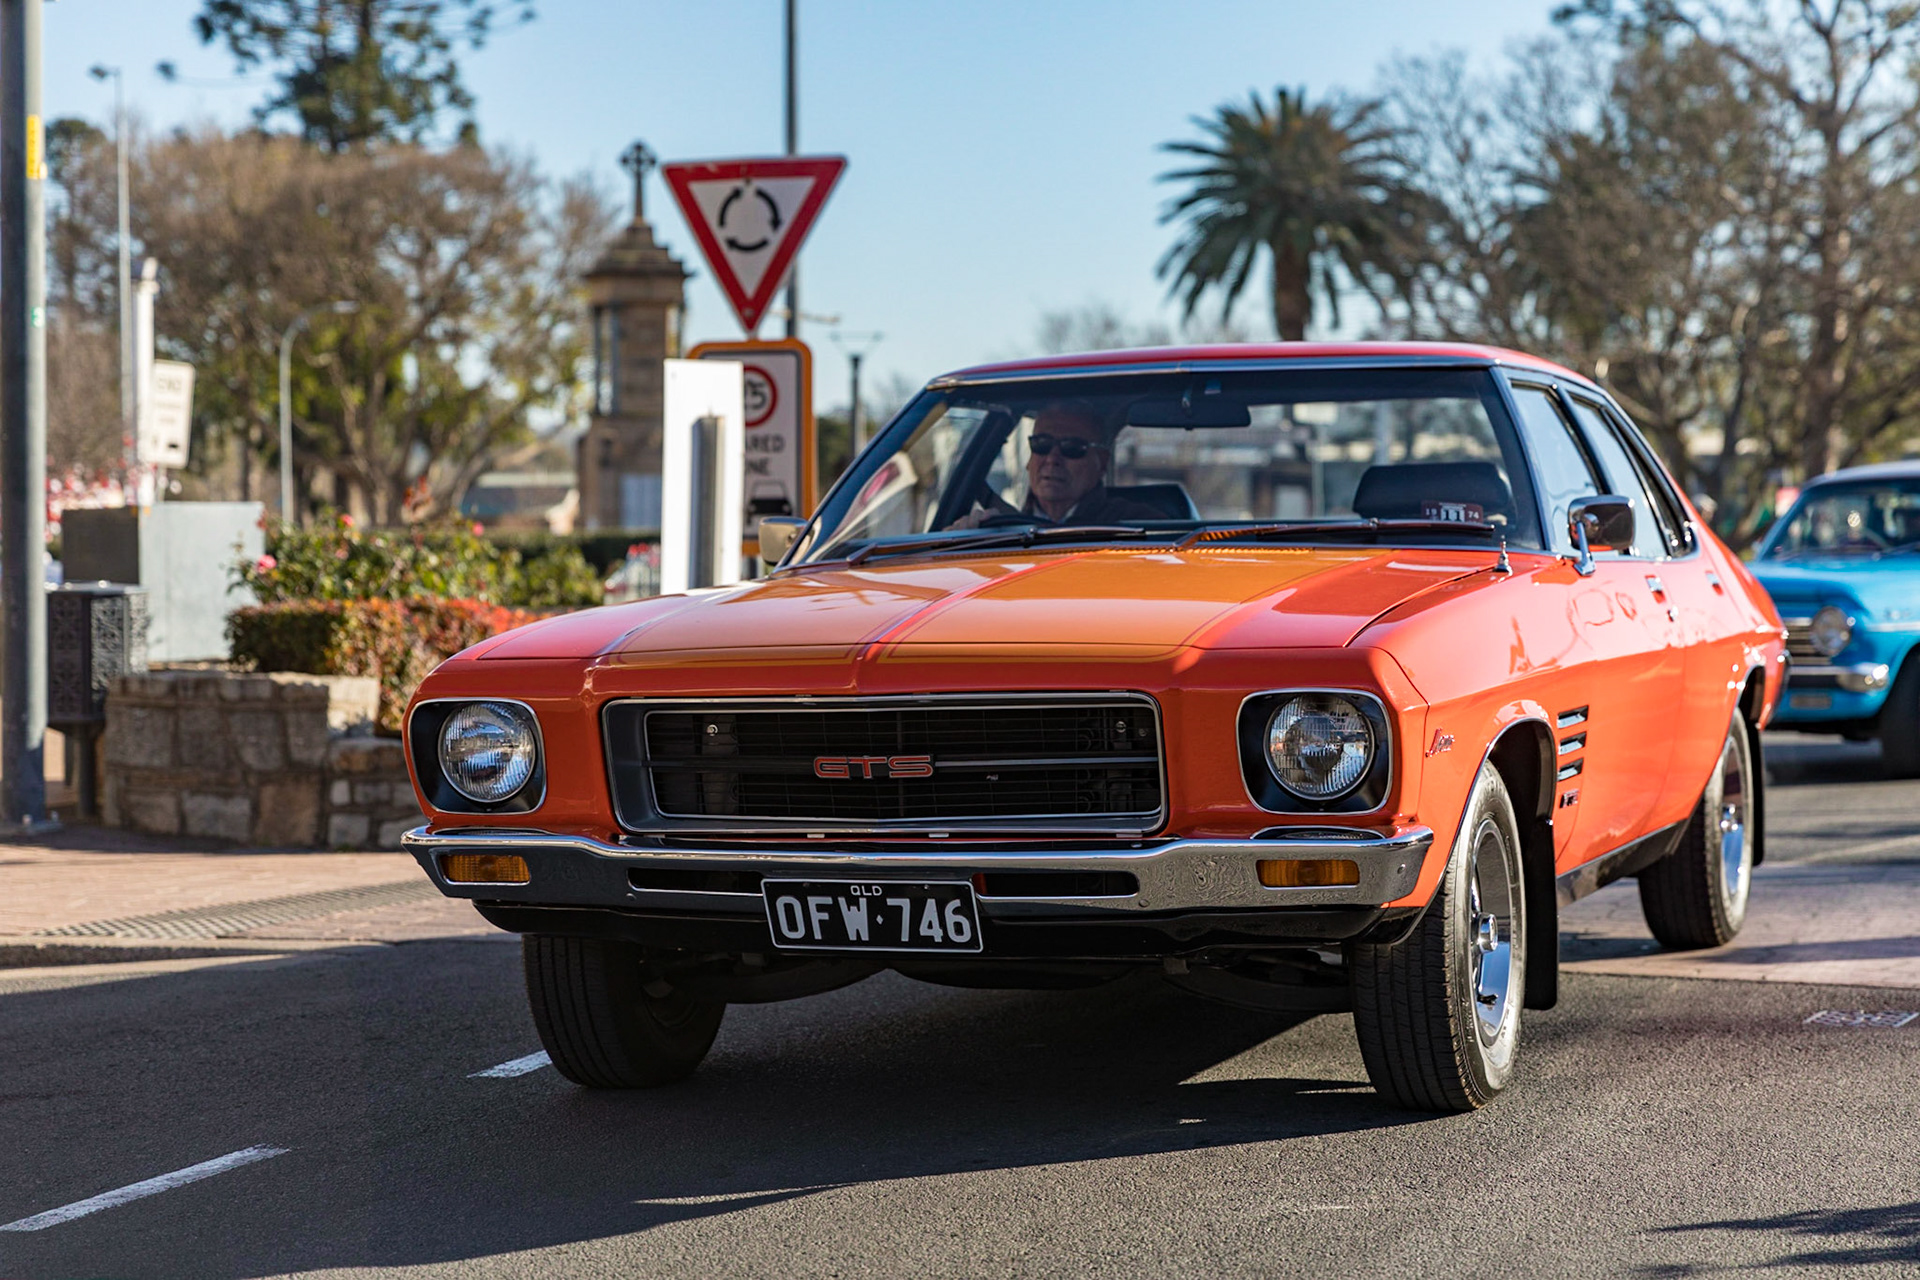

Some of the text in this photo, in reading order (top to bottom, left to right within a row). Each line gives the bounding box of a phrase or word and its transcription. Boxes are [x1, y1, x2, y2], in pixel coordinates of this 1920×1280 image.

[745, 380, 767, 410] 5
[745, 434, 786, 454] RED
[1467, 511, 1480, 519] 74
[814, 755, 934, 779] GTS
[850, 885, 883, 896] QLD
[775, 895, 972, 943] OFW 746
